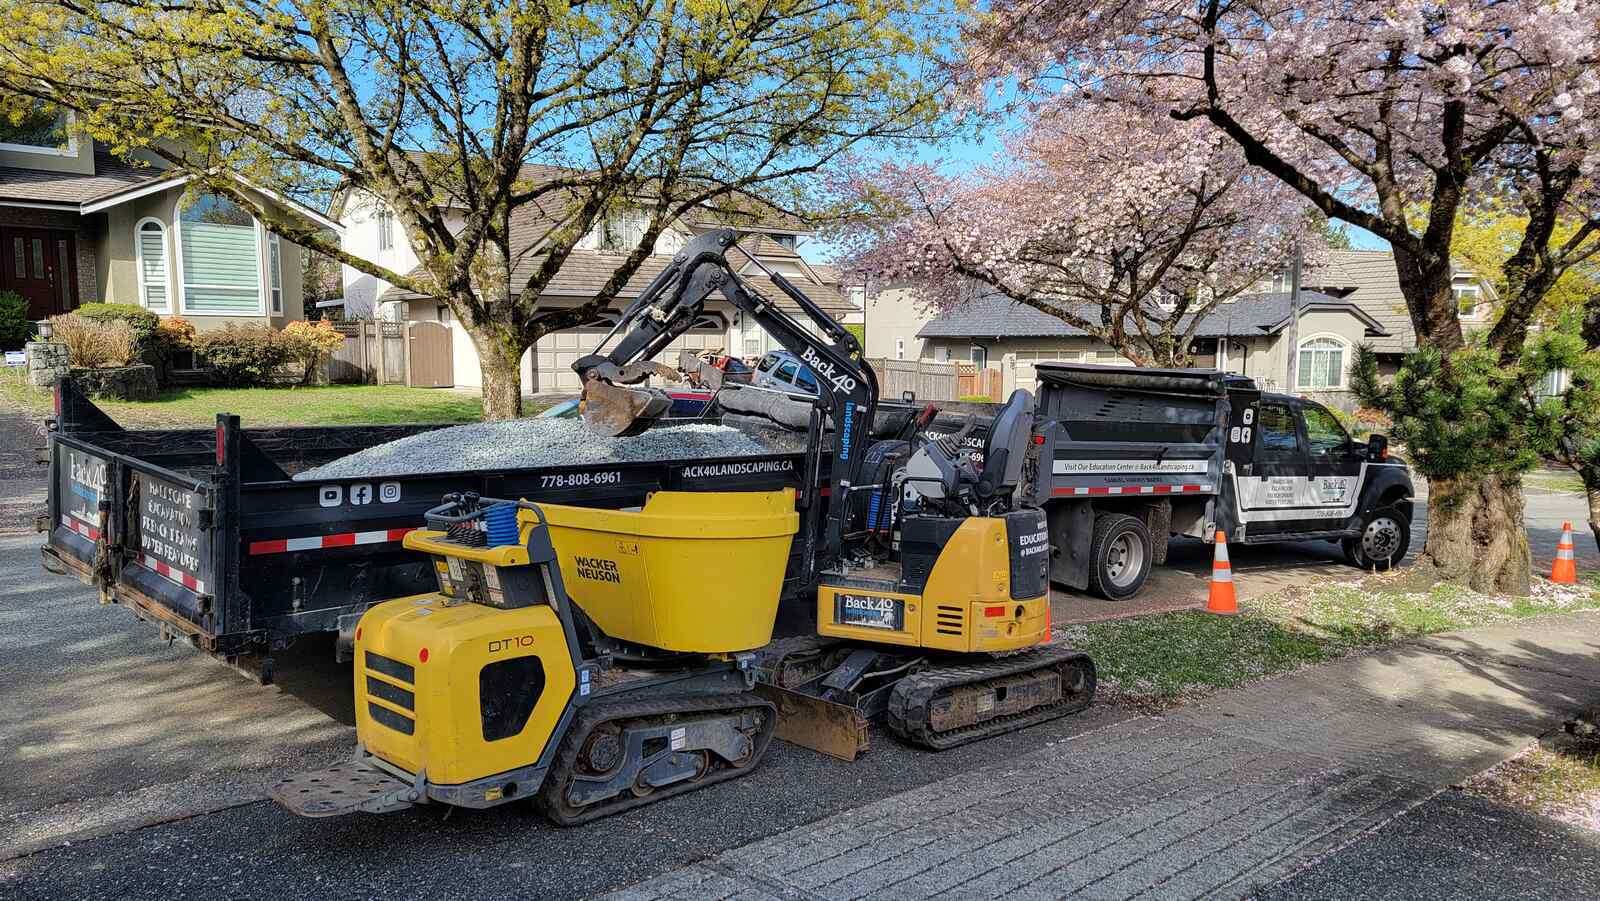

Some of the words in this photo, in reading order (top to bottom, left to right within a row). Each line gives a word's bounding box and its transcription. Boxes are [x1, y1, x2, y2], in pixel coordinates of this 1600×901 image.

[840, 402, 855, 460] landscaping
[682, 460, 793, 478] ACK40LANDSCAPING.CA
[541, 471, 621, 488] 778-808-6961
[574, 555, 618, 572] WACKER
[577, 568, 621, 583] NEUSON
[845, 595, 894, 617] Back40
